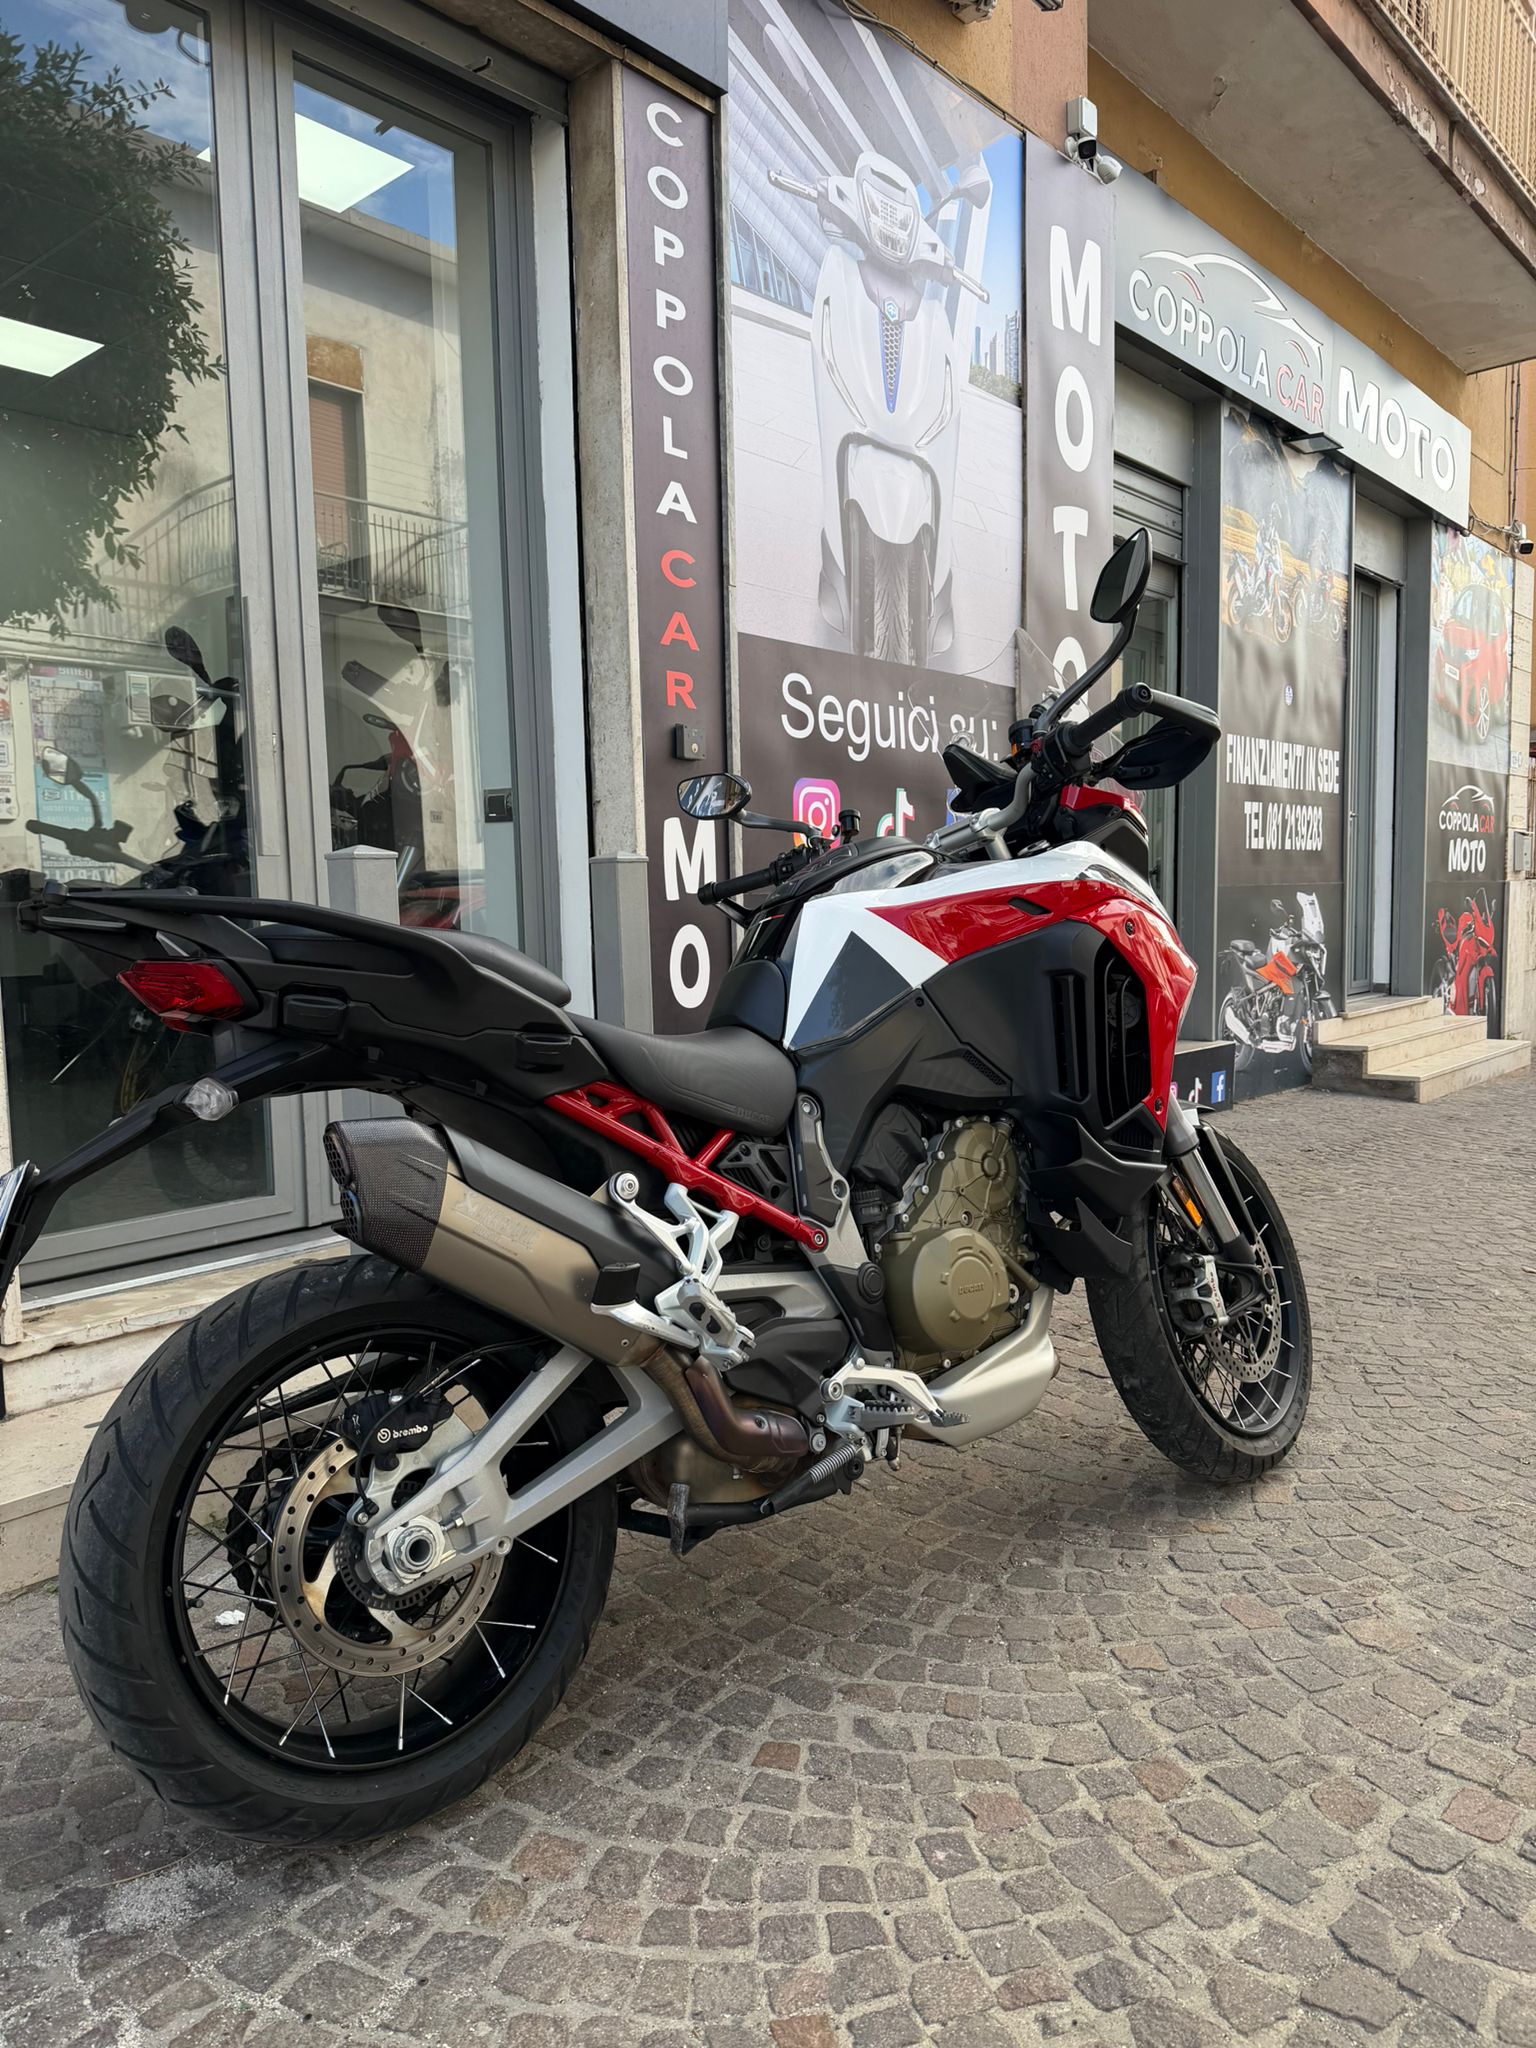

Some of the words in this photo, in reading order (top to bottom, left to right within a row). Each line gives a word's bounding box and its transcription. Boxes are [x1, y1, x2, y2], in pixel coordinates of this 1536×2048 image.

[1337, 365, 1456, 493] MOTO
[780, 672, 940, 762] Seguici
[1225, 733, 1305, 790] FINANZIAMENTI
[1305, 745, 1317, 791] IN
[1317, 747, 1340, 794] SEDE
[1244, 801, 1265, 849] TEL
[1265, 802, 1284, 850] 081
[1284, 804, 1323, 851] 2139283
[1447, 838, 1487, 873] MOTO
[392, 1424, 429, 1439] brembo
